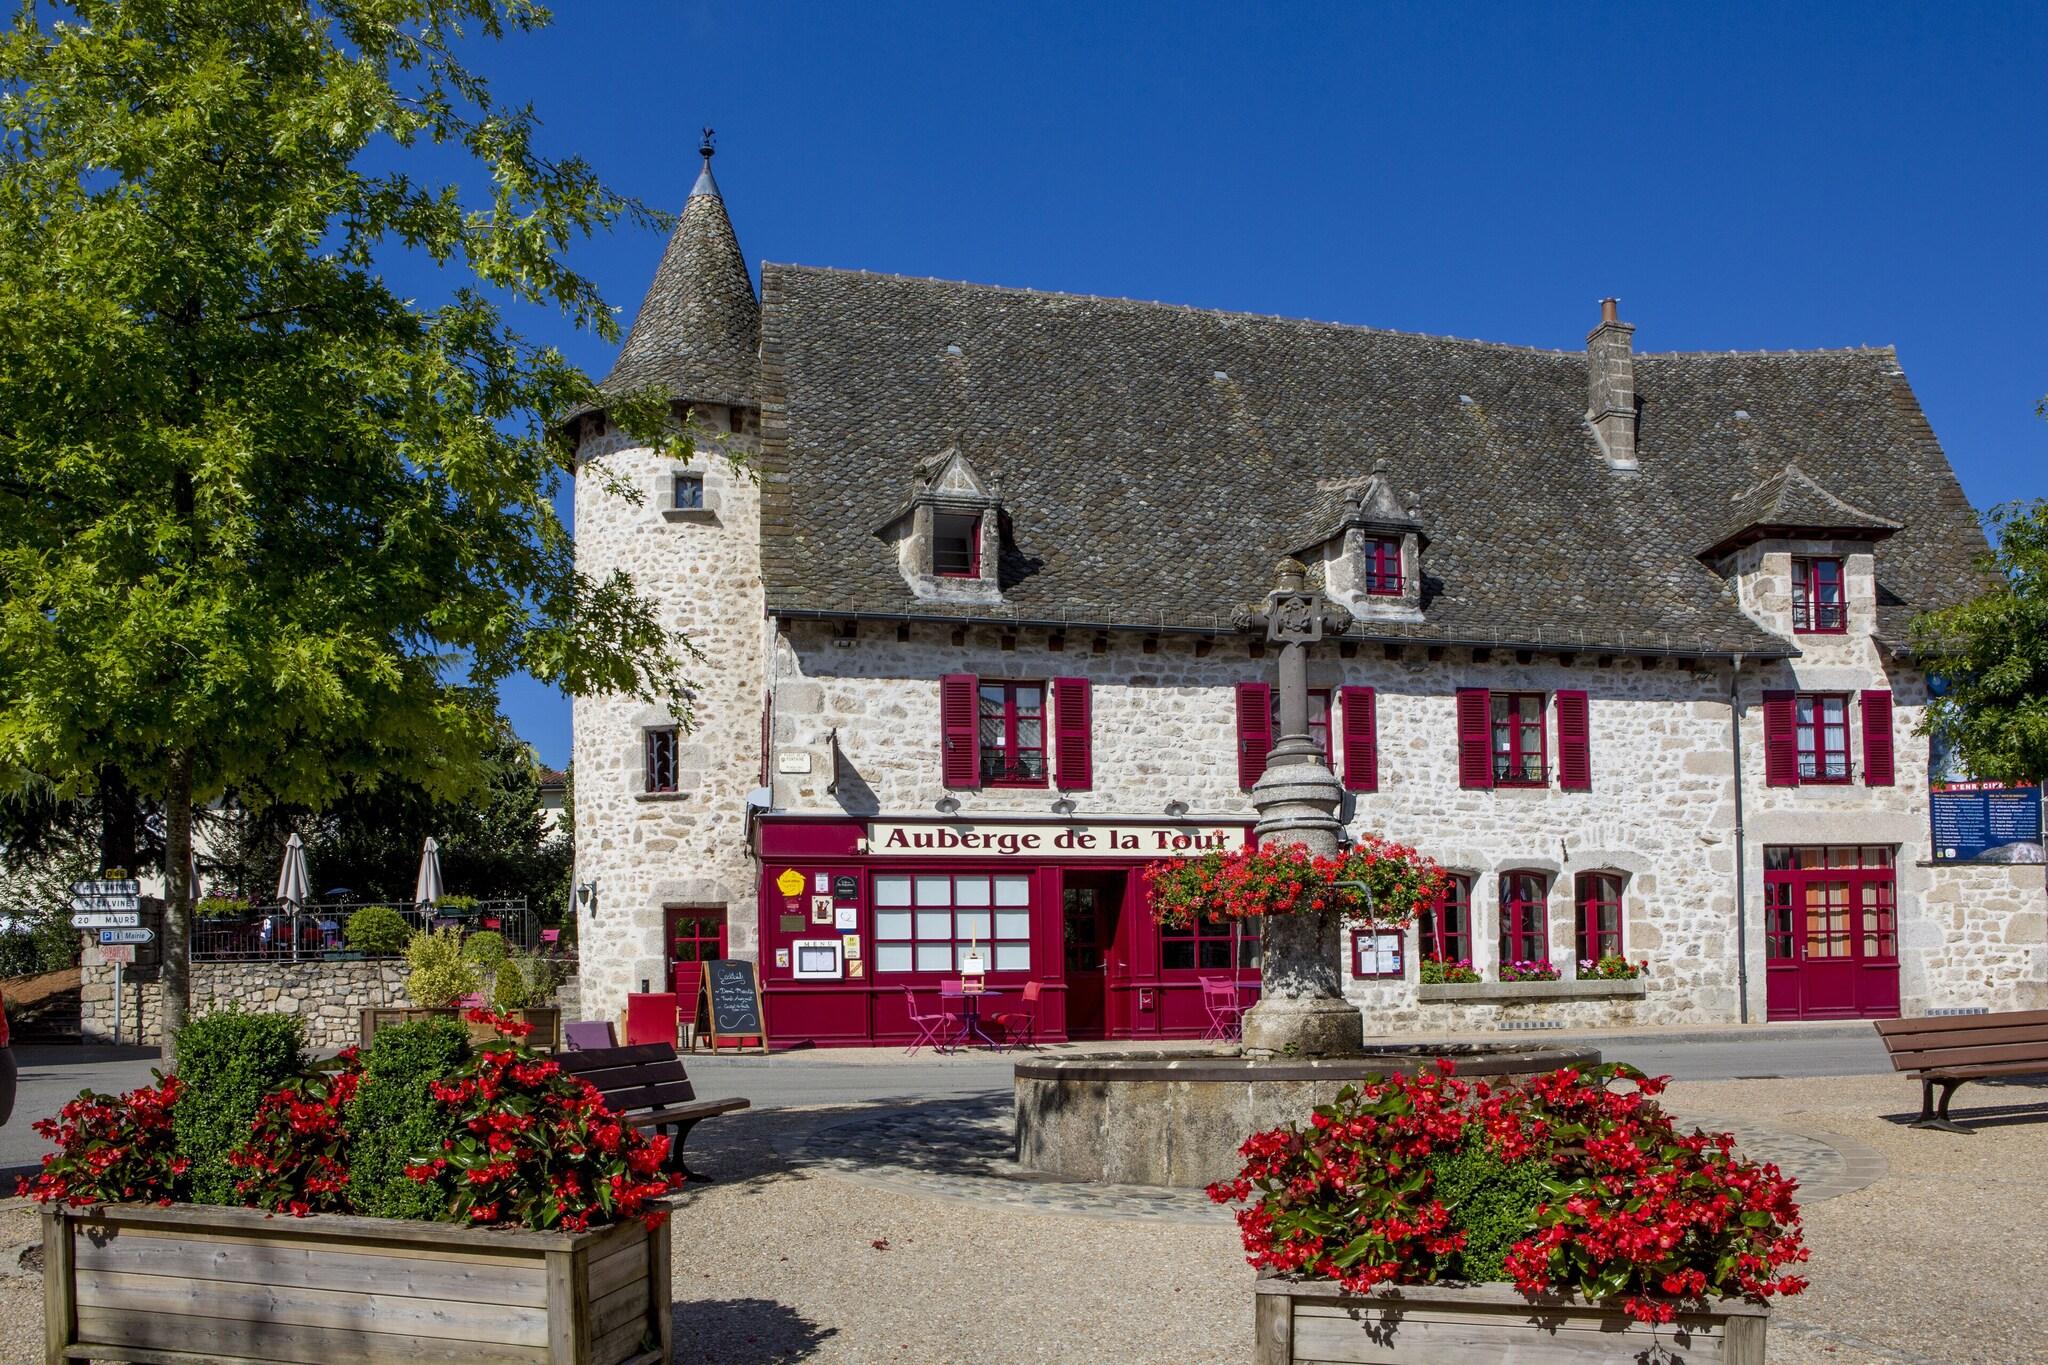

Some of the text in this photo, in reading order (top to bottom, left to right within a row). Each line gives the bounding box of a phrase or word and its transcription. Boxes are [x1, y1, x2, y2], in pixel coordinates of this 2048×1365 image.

[885, 828, 1230, 855] Auberge de la Tour
